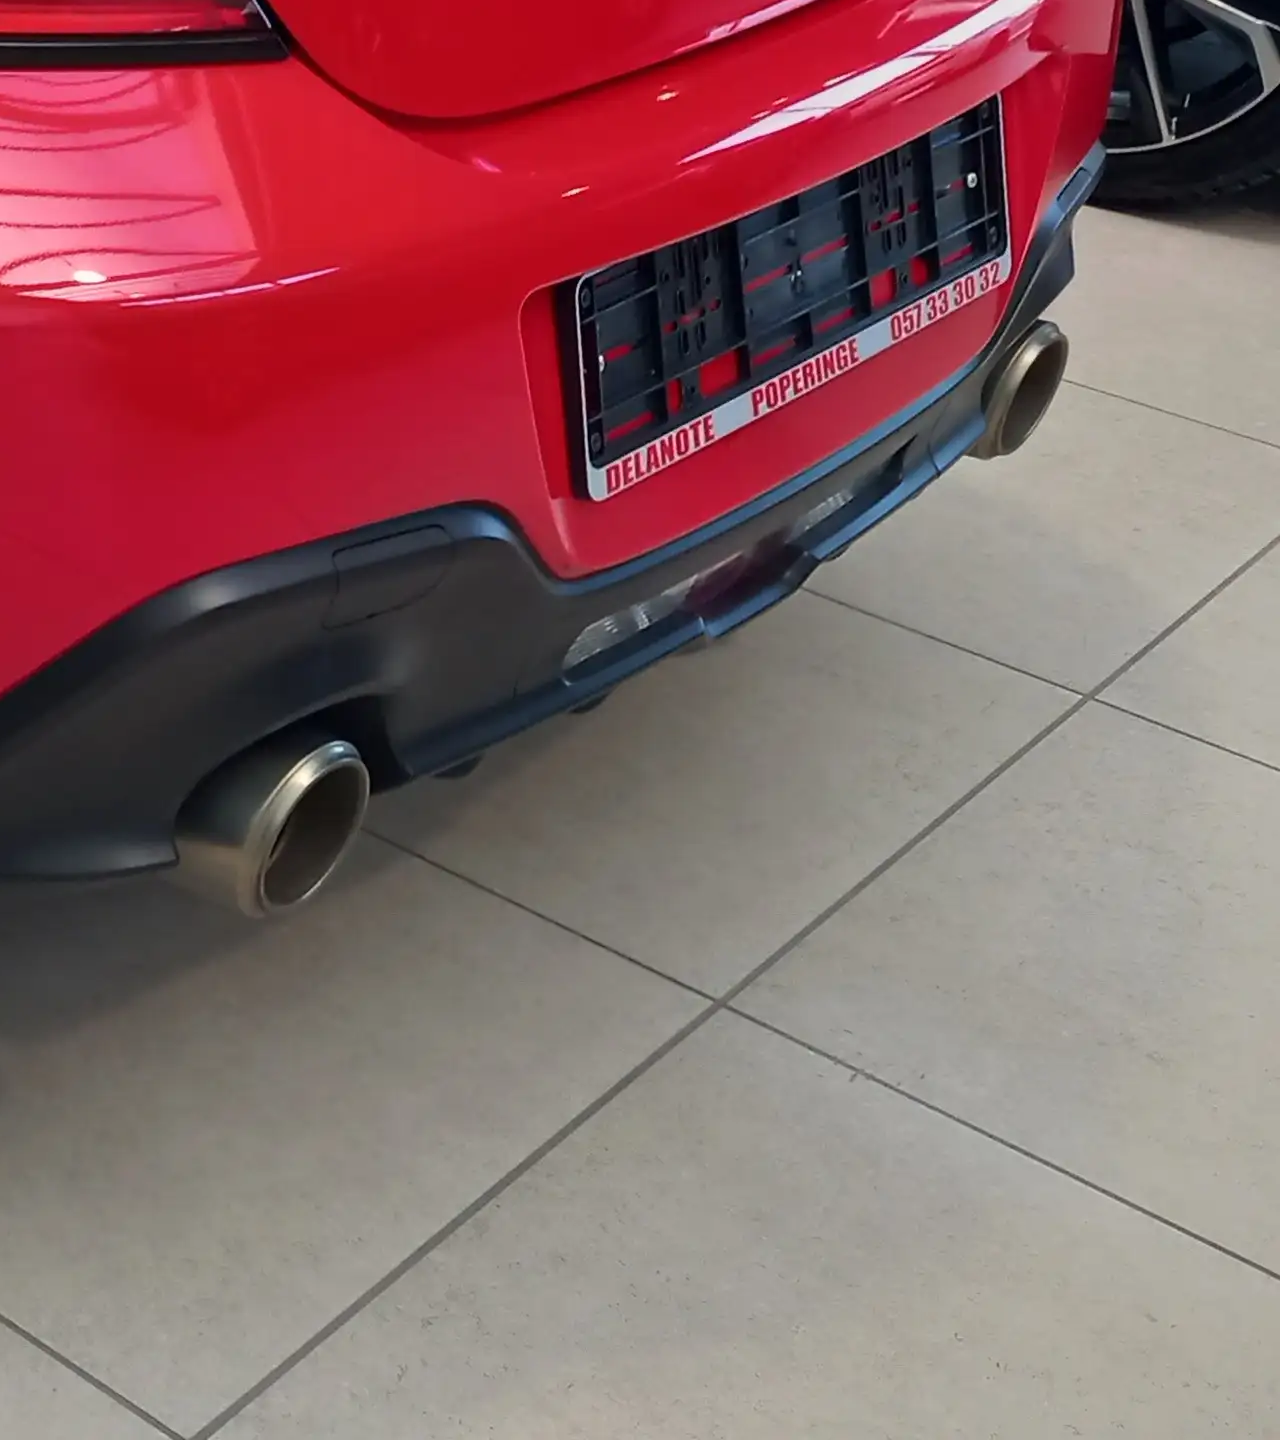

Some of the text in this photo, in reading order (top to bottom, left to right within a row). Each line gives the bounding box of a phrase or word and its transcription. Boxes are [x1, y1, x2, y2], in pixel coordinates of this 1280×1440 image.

[606, 261, 1000, 494] DELANOTE POPERINGE 057 33 30 32
